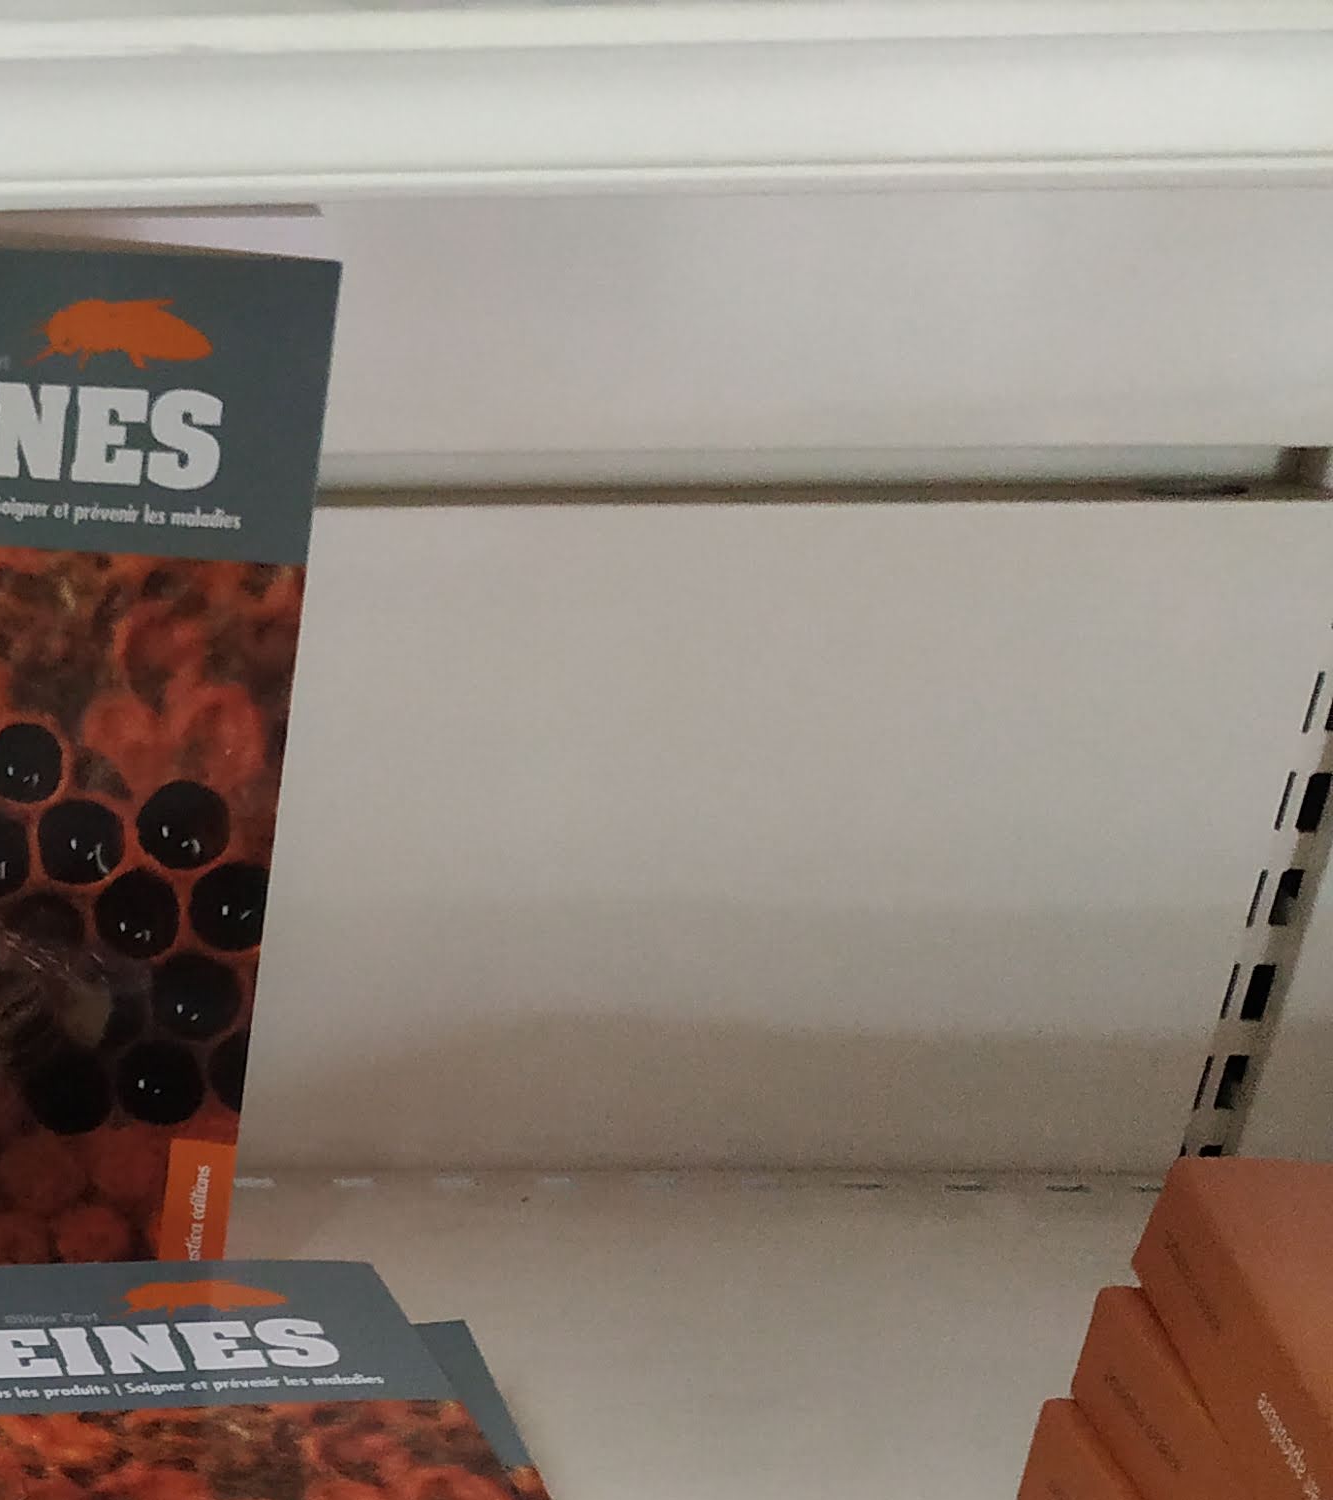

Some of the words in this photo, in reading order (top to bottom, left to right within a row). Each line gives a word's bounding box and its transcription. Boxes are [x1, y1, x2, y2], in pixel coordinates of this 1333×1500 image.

[53, 502, 70, 519] et
[73, 502, 139, 526] prévenir
[143, 505, 166, 526] les
[170, 507, 242, 530] maladies
[16, 1385, 39, 1399] les
[42, 1383, 111, 1400] produits
[124, 1381, 185, 1397] Soigner
[191, 1379, 209, 1392] et
[211, 1375, 280, 1393] prévenir
[282, 1374, 309, 1388] les
[311, 1372, 385, 1387] maladies
